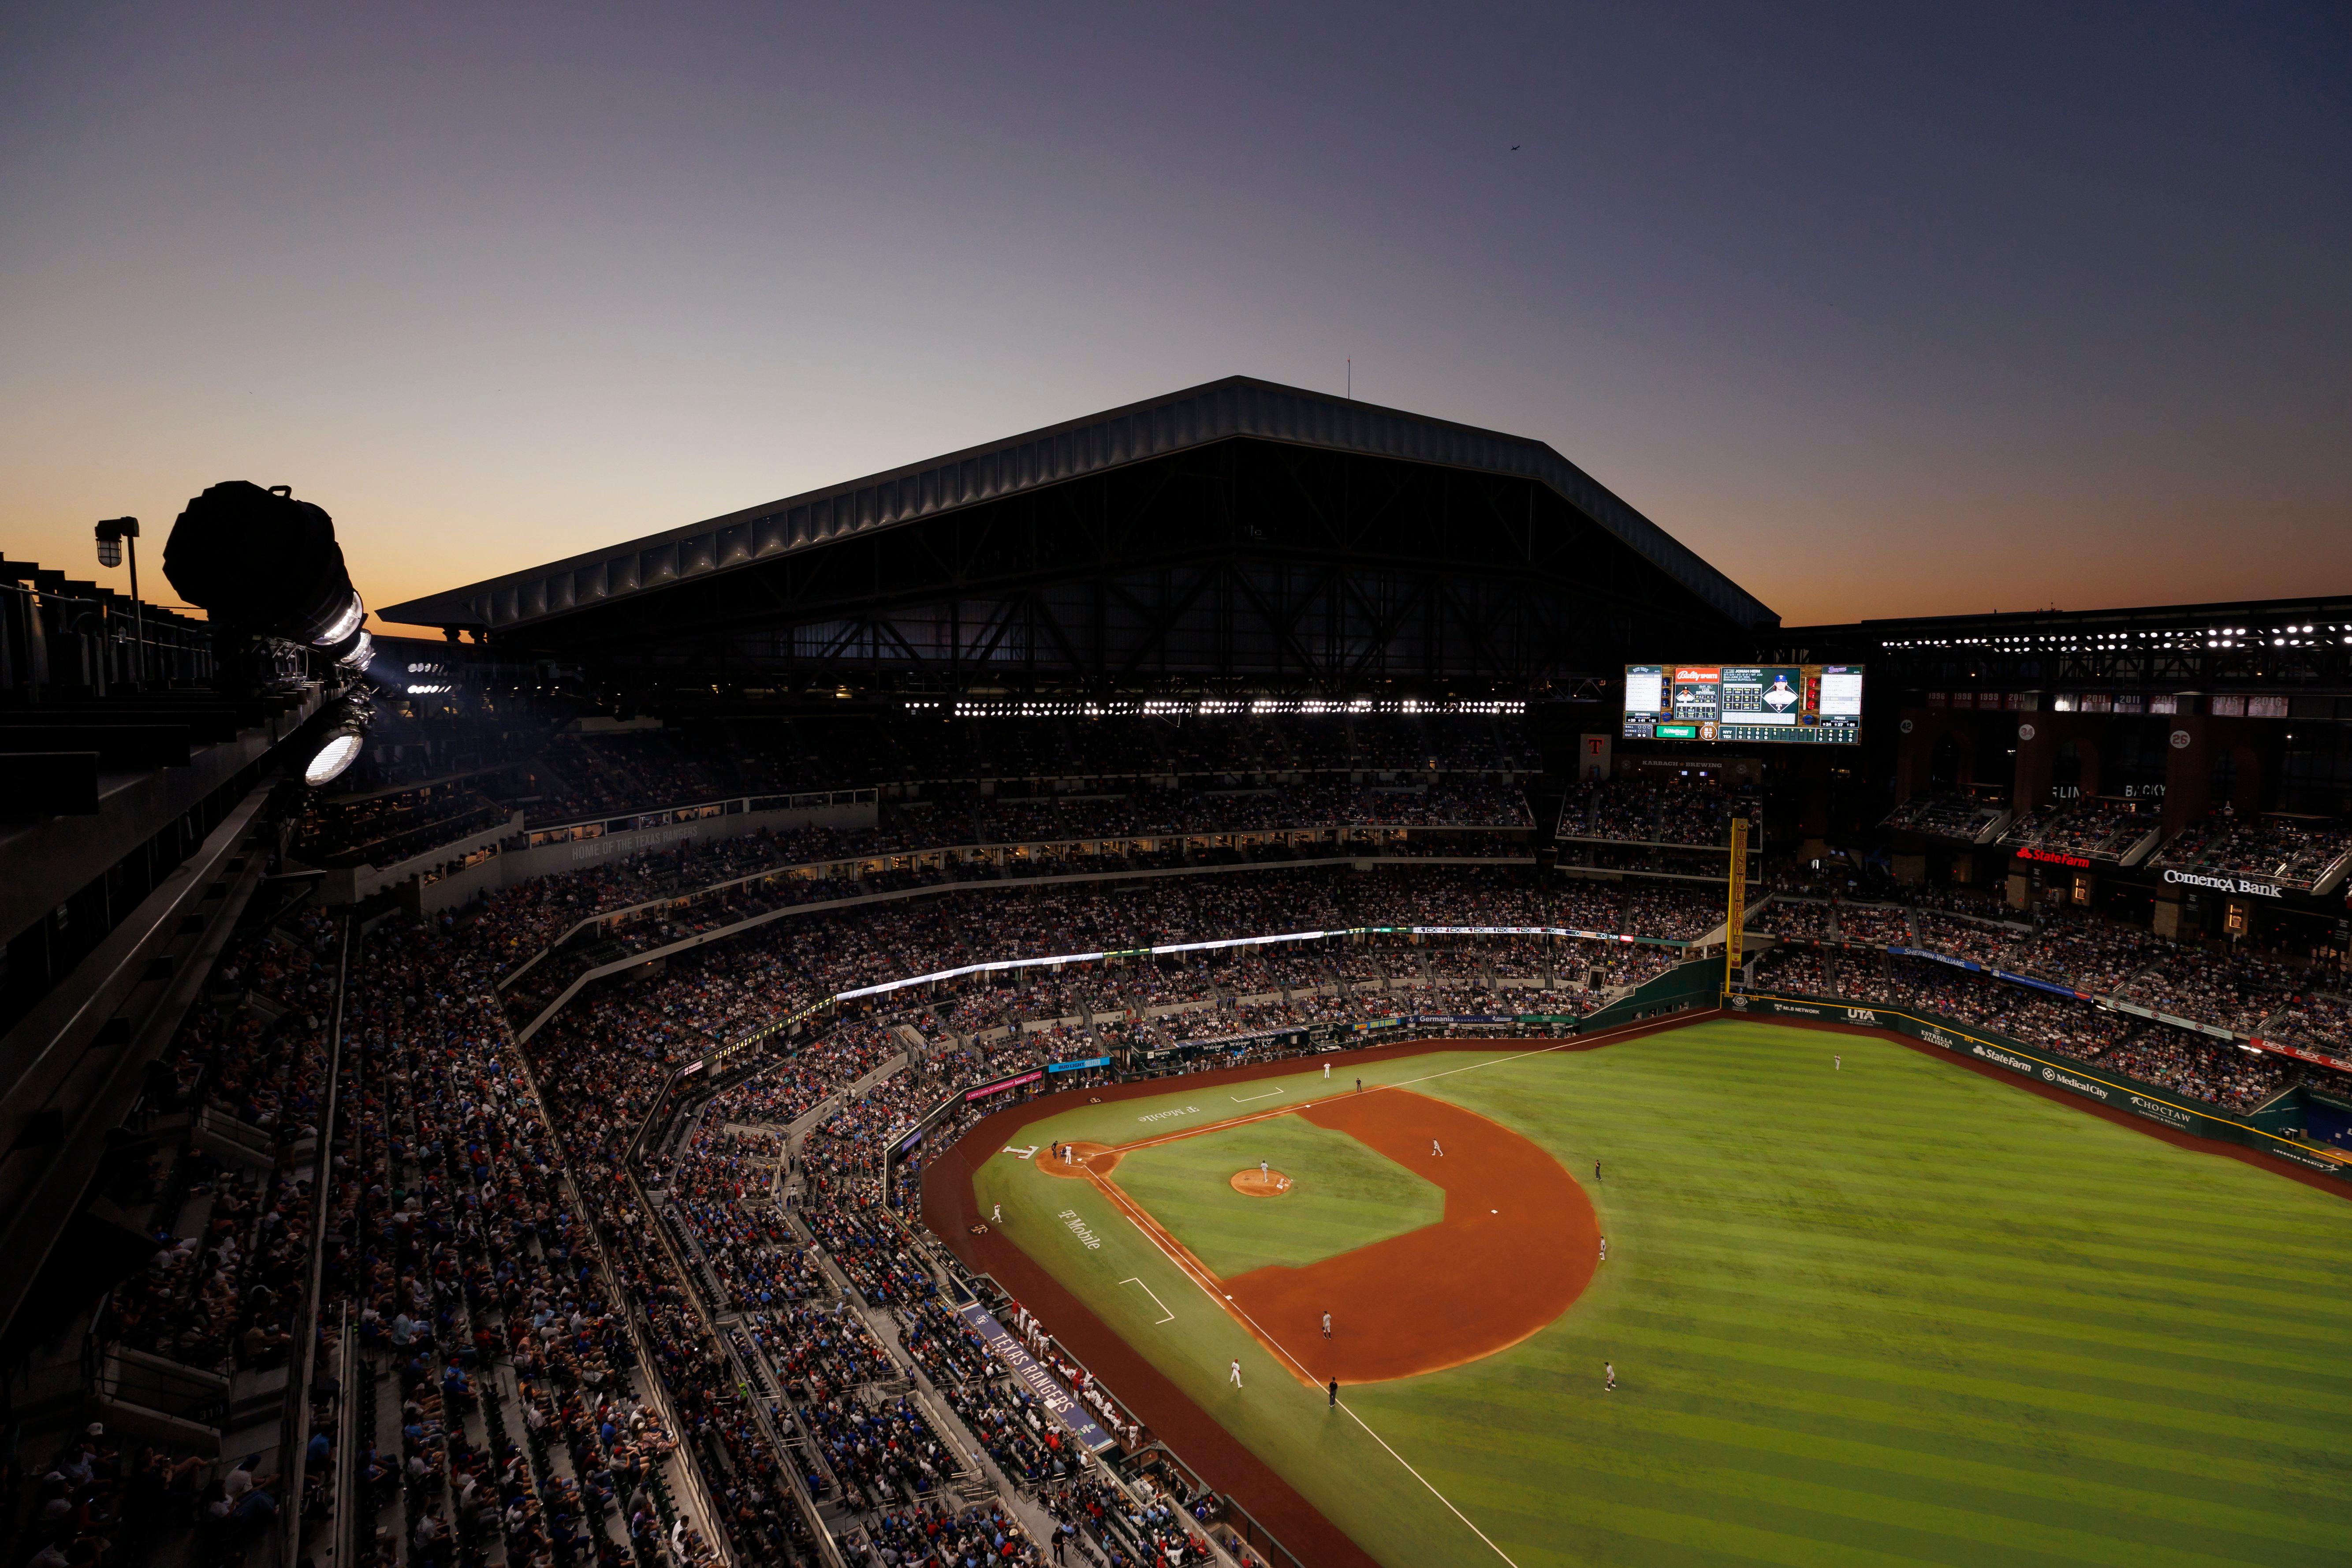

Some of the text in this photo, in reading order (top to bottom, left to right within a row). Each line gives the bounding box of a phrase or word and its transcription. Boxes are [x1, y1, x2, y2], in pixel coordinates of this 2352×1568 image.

[1677, 670, 1701, 681] Bally
[2119, 695, 2140, 704] 2011
[2212, 696, 2238, 705] 2015
[2255, 696, 2281, 705] 2016
[2021, 727, 2035, 737] 34
[2173, 735, 2188, 744] 26
[1588, 738, 1603, 755] T
[573, 826, 697, 860] HOME OF THE TEXAS RANGERS
[2238, 881, 2282, 898] Bank
[1848, 1008, 1875, 1021] UTA
[1921, 1030, 1953, 1045] ESTRELLA
[1923, 1036, 1949, 1049] JALISCO
[2262, 1040, 2286, 1050] DEX
[2295, 1049, 2321, 1060] DEX
[994, 1082, 1014, 1090] MEMBERSHIP
[1138, 1109, 1184, 1123] Mobile
[2136, 1097, 2191, 1122] CHOCTAW
[2139, 1110, 2159, 1120] CASINOS
[2165, 1118, 2186, 1129] RESORTS
[2273, 1148, 2324, 1168] LOCKHEED MARTIN
[1064, 1217, 1100, 1250] Mobile
[991, 1333, 1074, 1413] TEXAS RANGERS
